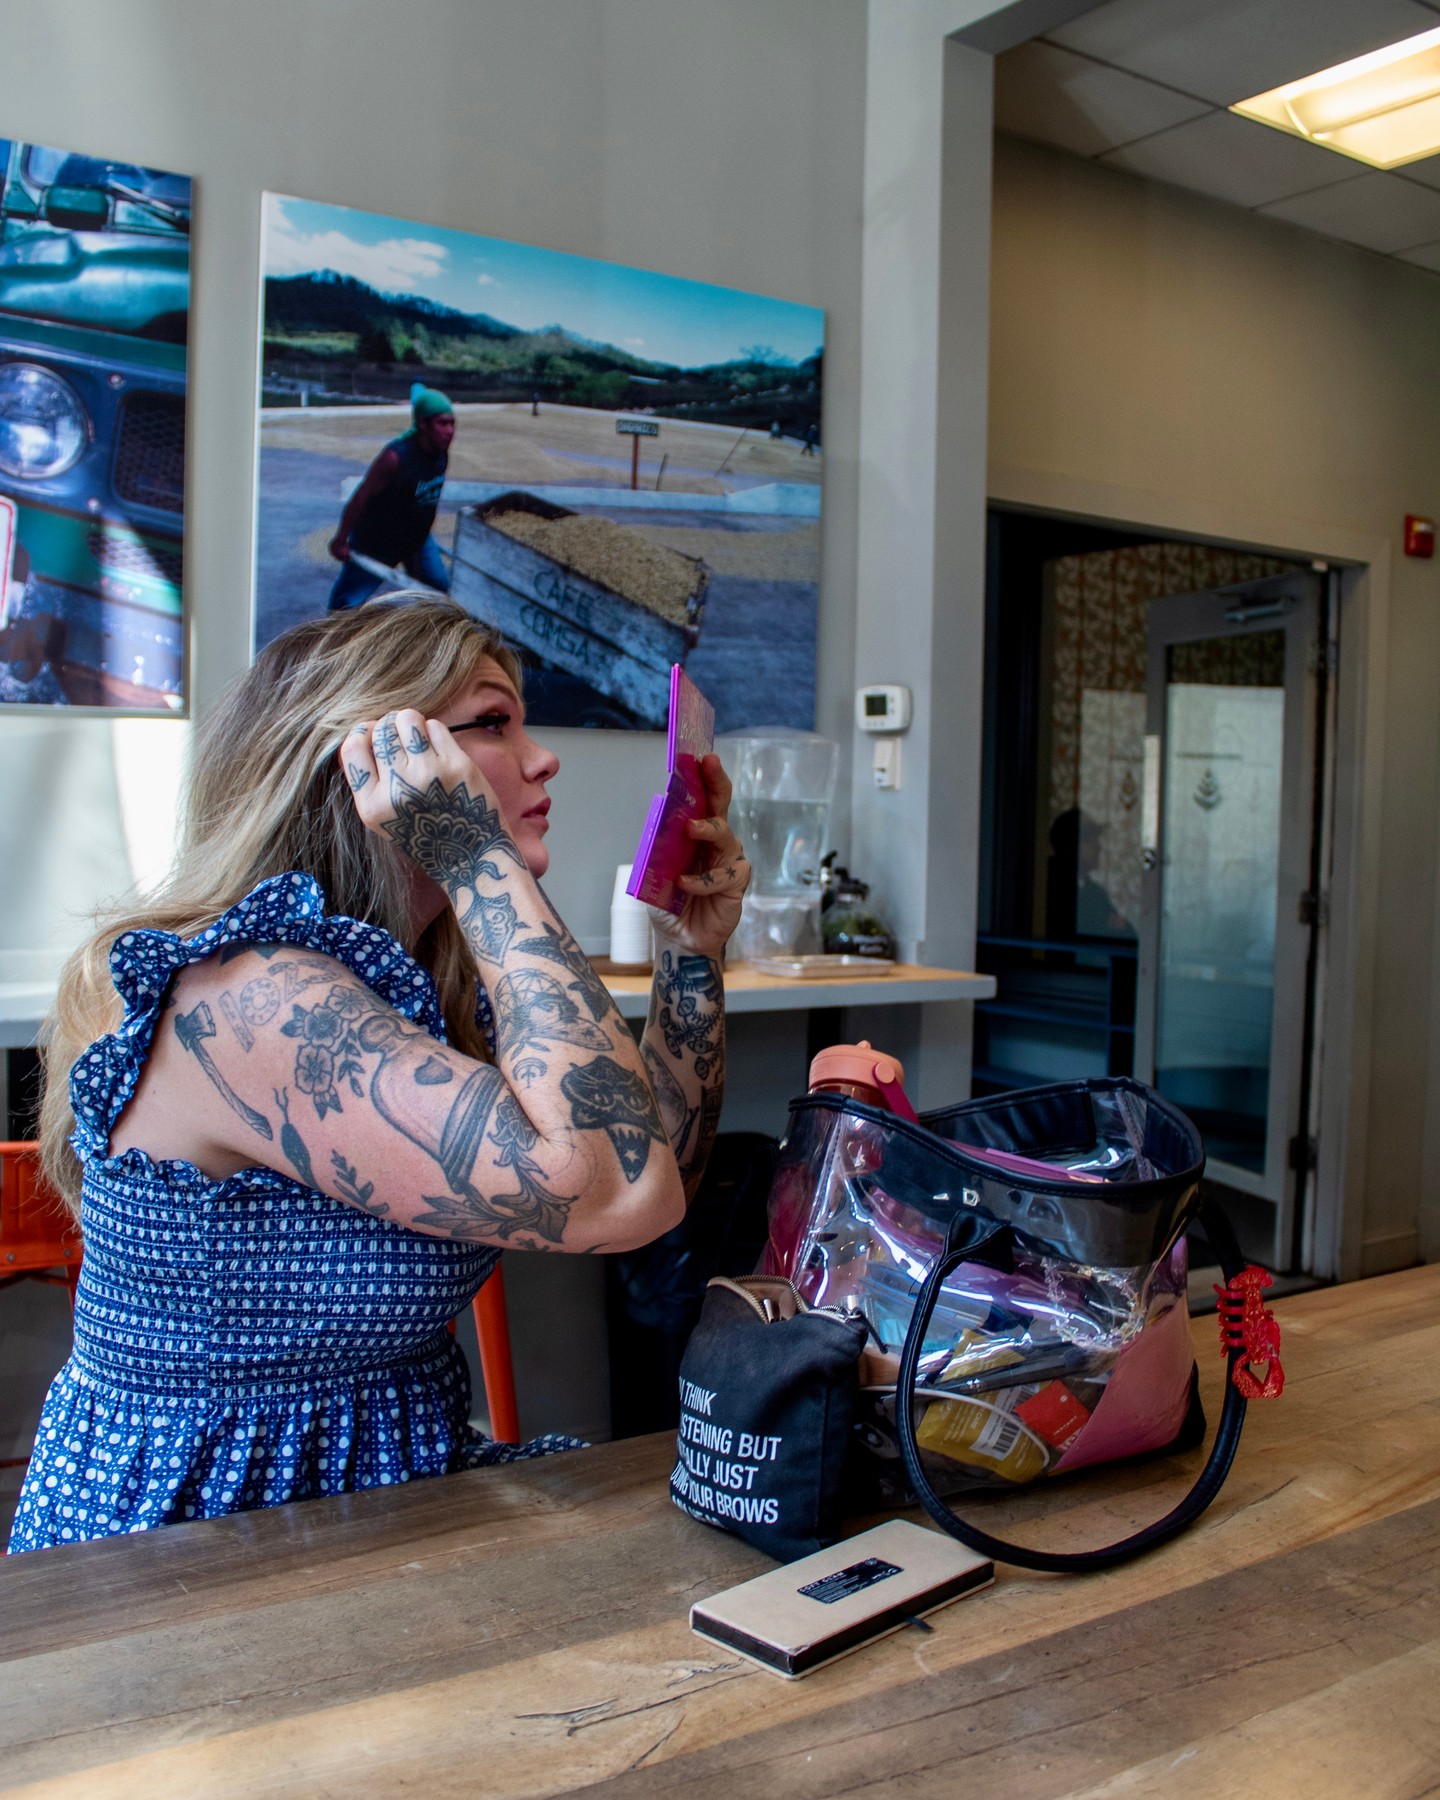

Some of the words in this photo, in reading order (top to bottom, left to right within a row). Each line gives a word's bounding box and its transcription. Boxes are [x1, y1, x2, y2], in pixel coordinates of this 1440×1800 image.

[683, 1381, 717, 1416] THINK
[681, 1412, 733, 1455] STENING
[737, 1432, 782, 1461] BUT
[713, 1459, 759, 1490] JUST
[688, 1478, 715, 1511] YOUR
[716, 1490, 779, 1524] BROWS
